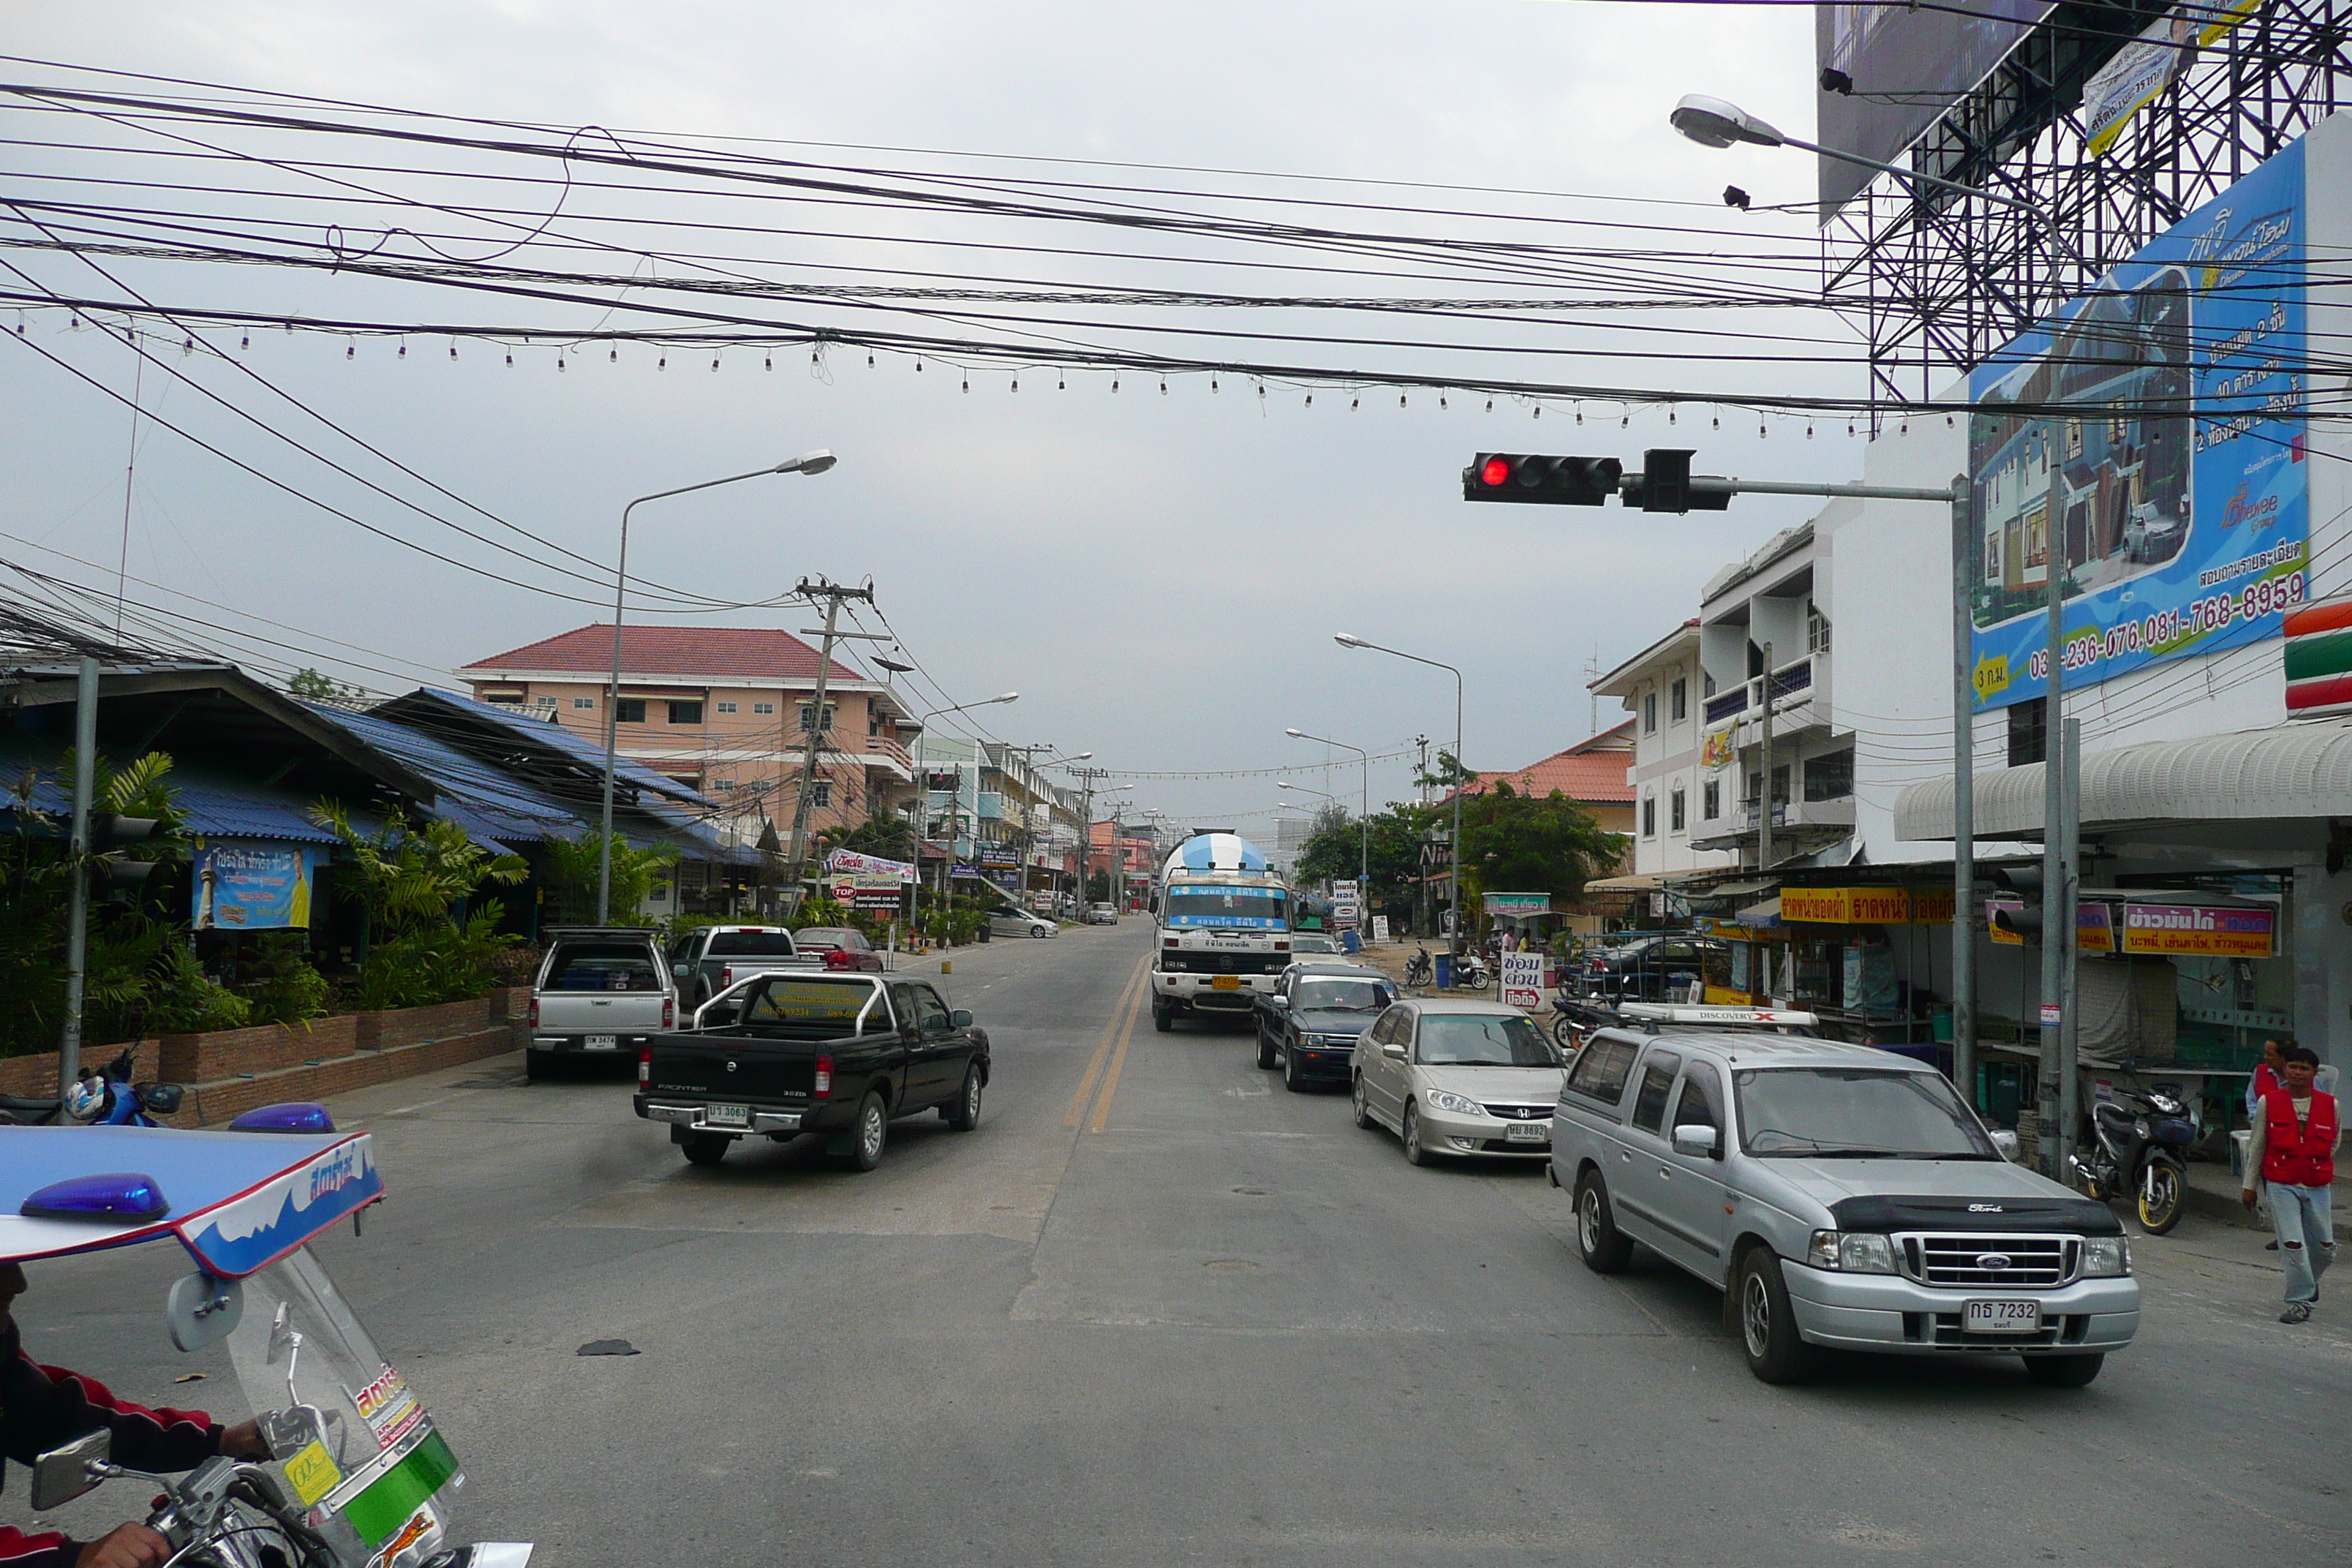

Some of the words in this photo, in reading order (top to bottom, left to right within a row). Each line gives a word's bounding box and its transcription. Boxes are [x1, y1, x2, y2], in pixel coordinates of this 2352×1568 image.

[2196, 434, 2204, 453] 2
[2198, 538, 2302, 587] สอบถามรายละเอียด
[2030, 573, 2304, 678] 03-236-076,081-768-8959
[1978, 671, 1985, 687] 3
[835, 888, 854, 896] TOP
[1504, 954, 1540, 970] ซ่อม
[1504, 970, 1538, 985] ด่วน
[1700, 1012, 1752, 1020] DISCOVERY
[658, 1084, 706, 1092] FRONTIER
[725, 1107, 747, 1118] 3063
[1524, 1126, 1544, 1135] 8692
[1968, 1203, 2003, 1213] Ford
[1998, 1303, 2035, 1319] 7232
